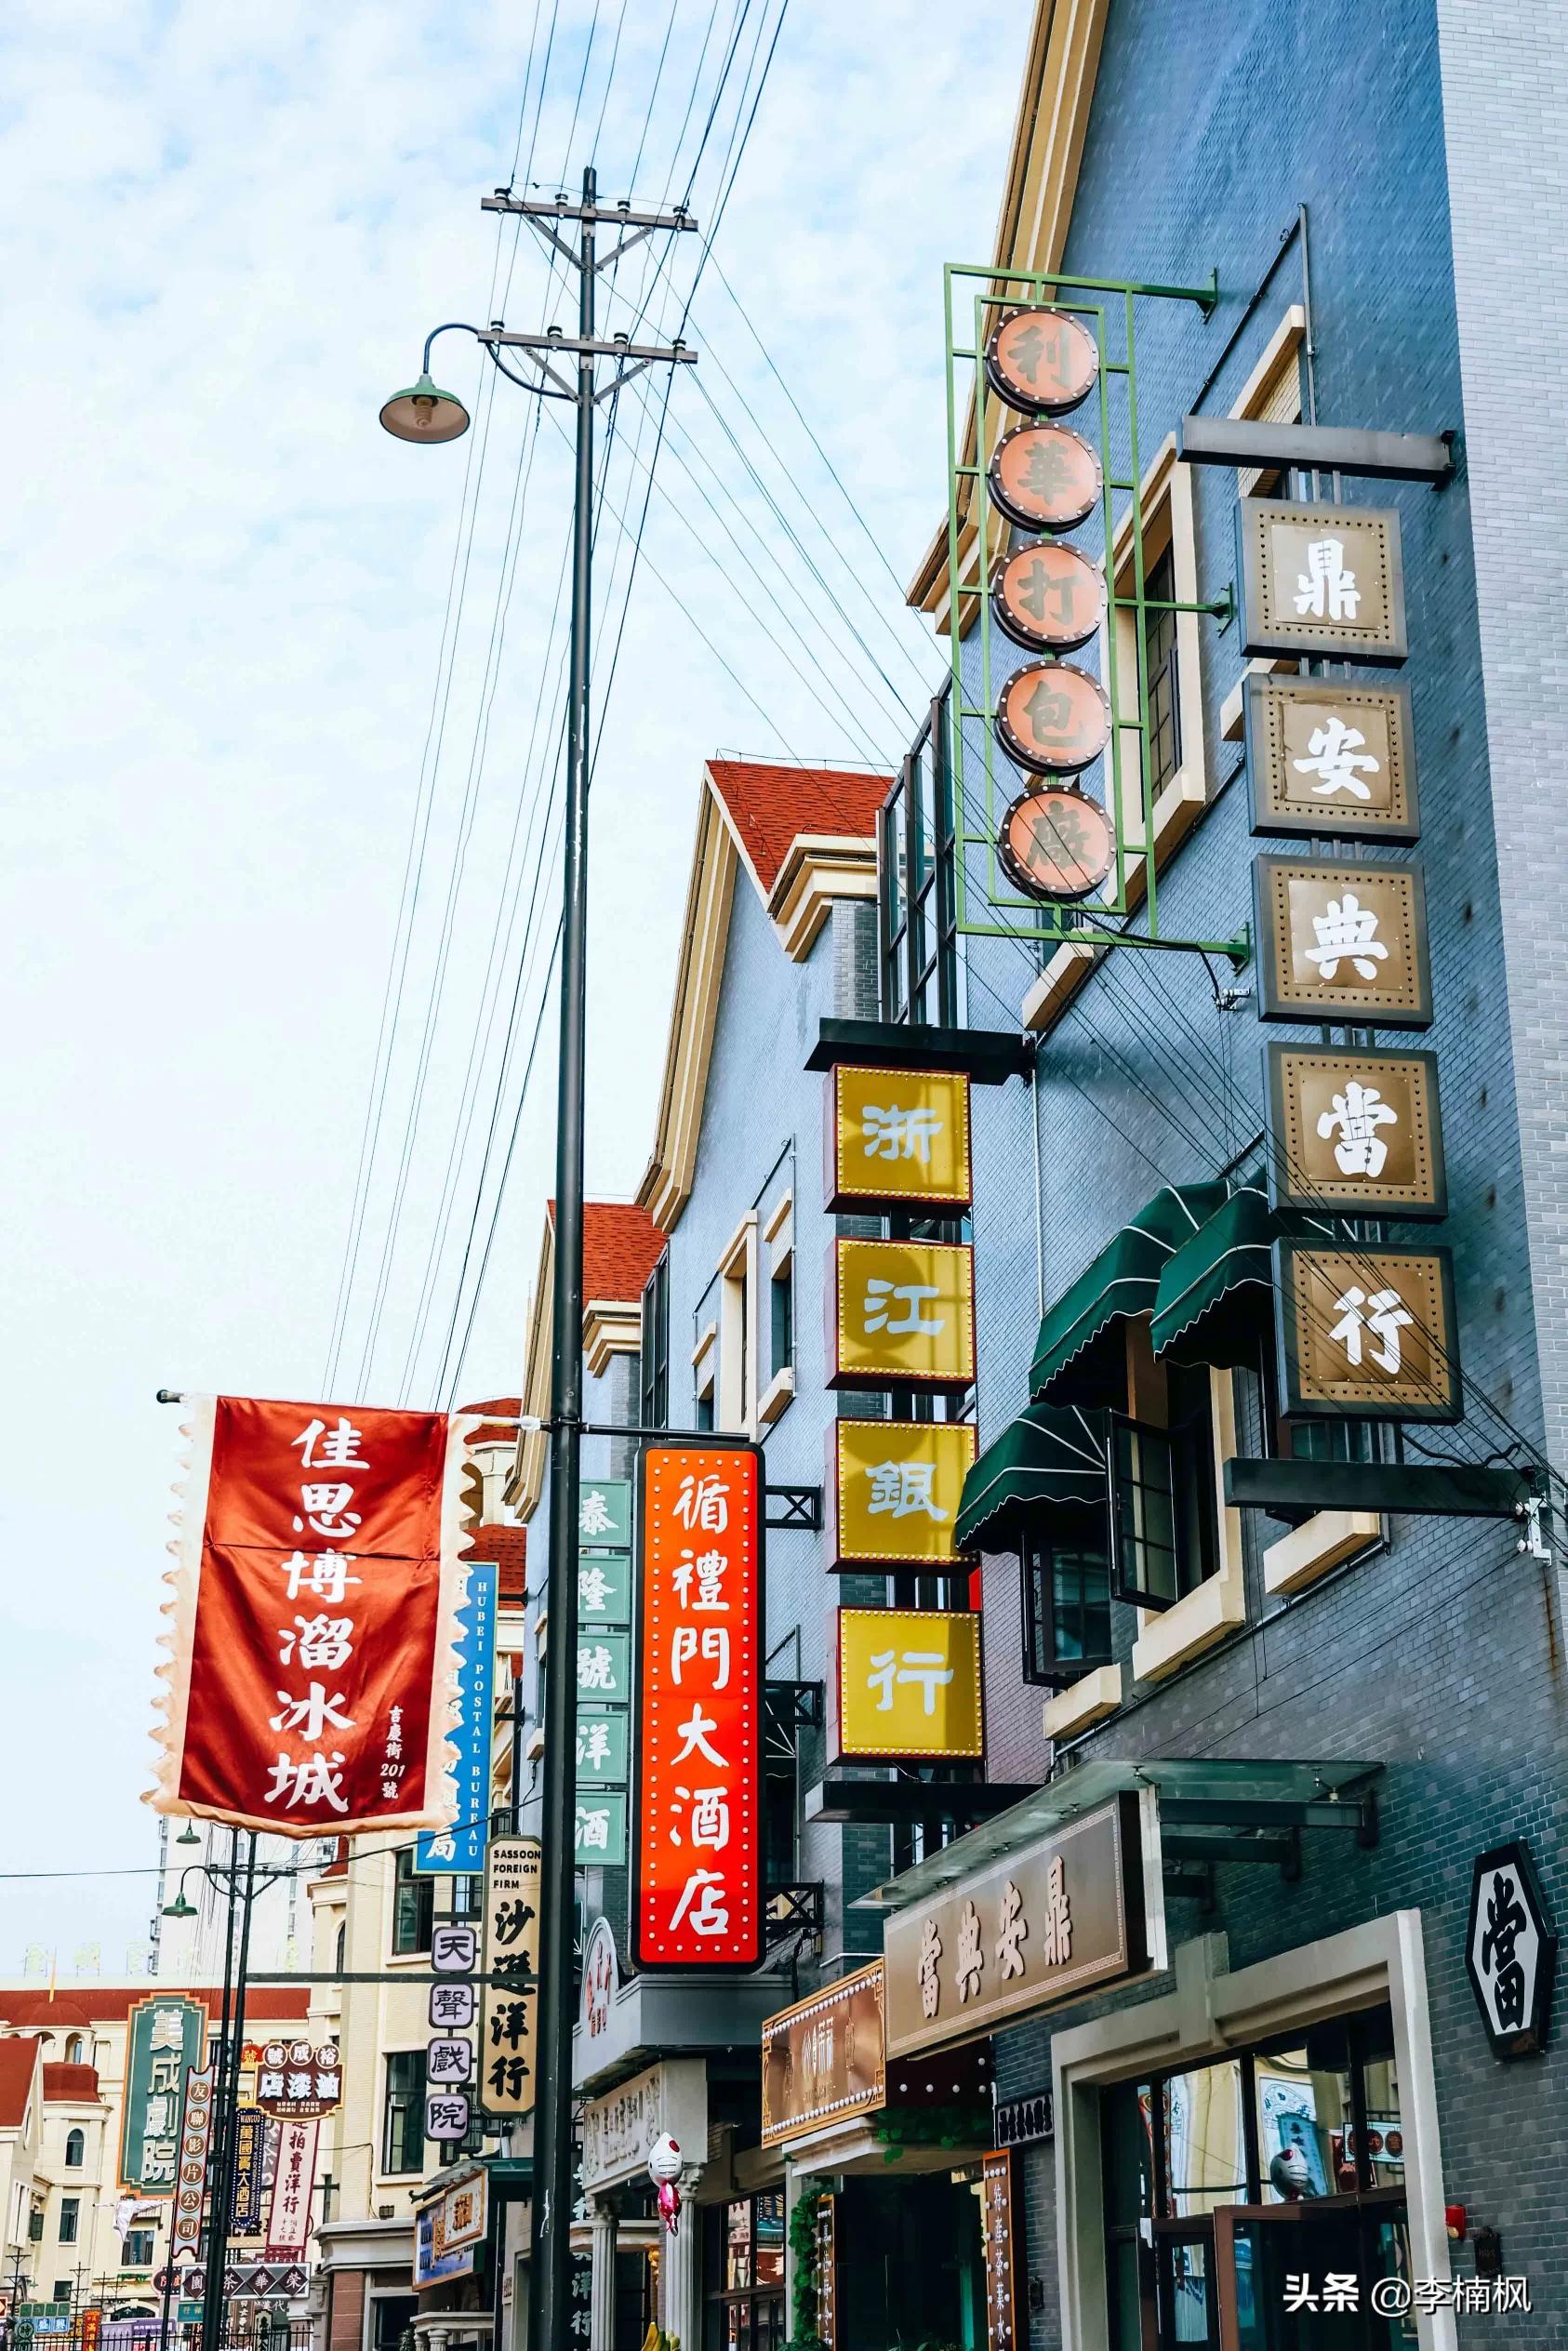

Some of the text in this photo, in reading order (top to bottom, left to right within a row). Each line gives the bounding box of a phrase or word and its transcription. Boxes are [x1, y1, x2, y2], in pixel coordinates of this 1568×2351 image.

[1294, 537, 1414, 1377] 鼎安典當行
[862, 1104, 954, 1717] 浙江銀行
[263, 1416, 370, 1813] 佳思博溜冰城
[575, 1489, 619, 1851] 泰隆號洋酒
[669, 1474, 730, 1936] 循禮門大酒店
[469, 1582, 487, 1856] HUBEI POSTAL BUREAU
[493, 1849, 541, 1860] SASSOON
[493, 1864, 538, 1875] FOREIGN
[493, 1879, 521, 1890] FIRM
[140, 2009, 184, 2183] 美成劇院
[431, 1935, 472, 2131] 天聲戲院
[180, 2082, 208, 2237] 友聯影片公司
[993, 2184, 1005, 2351] 特產茶葉水
